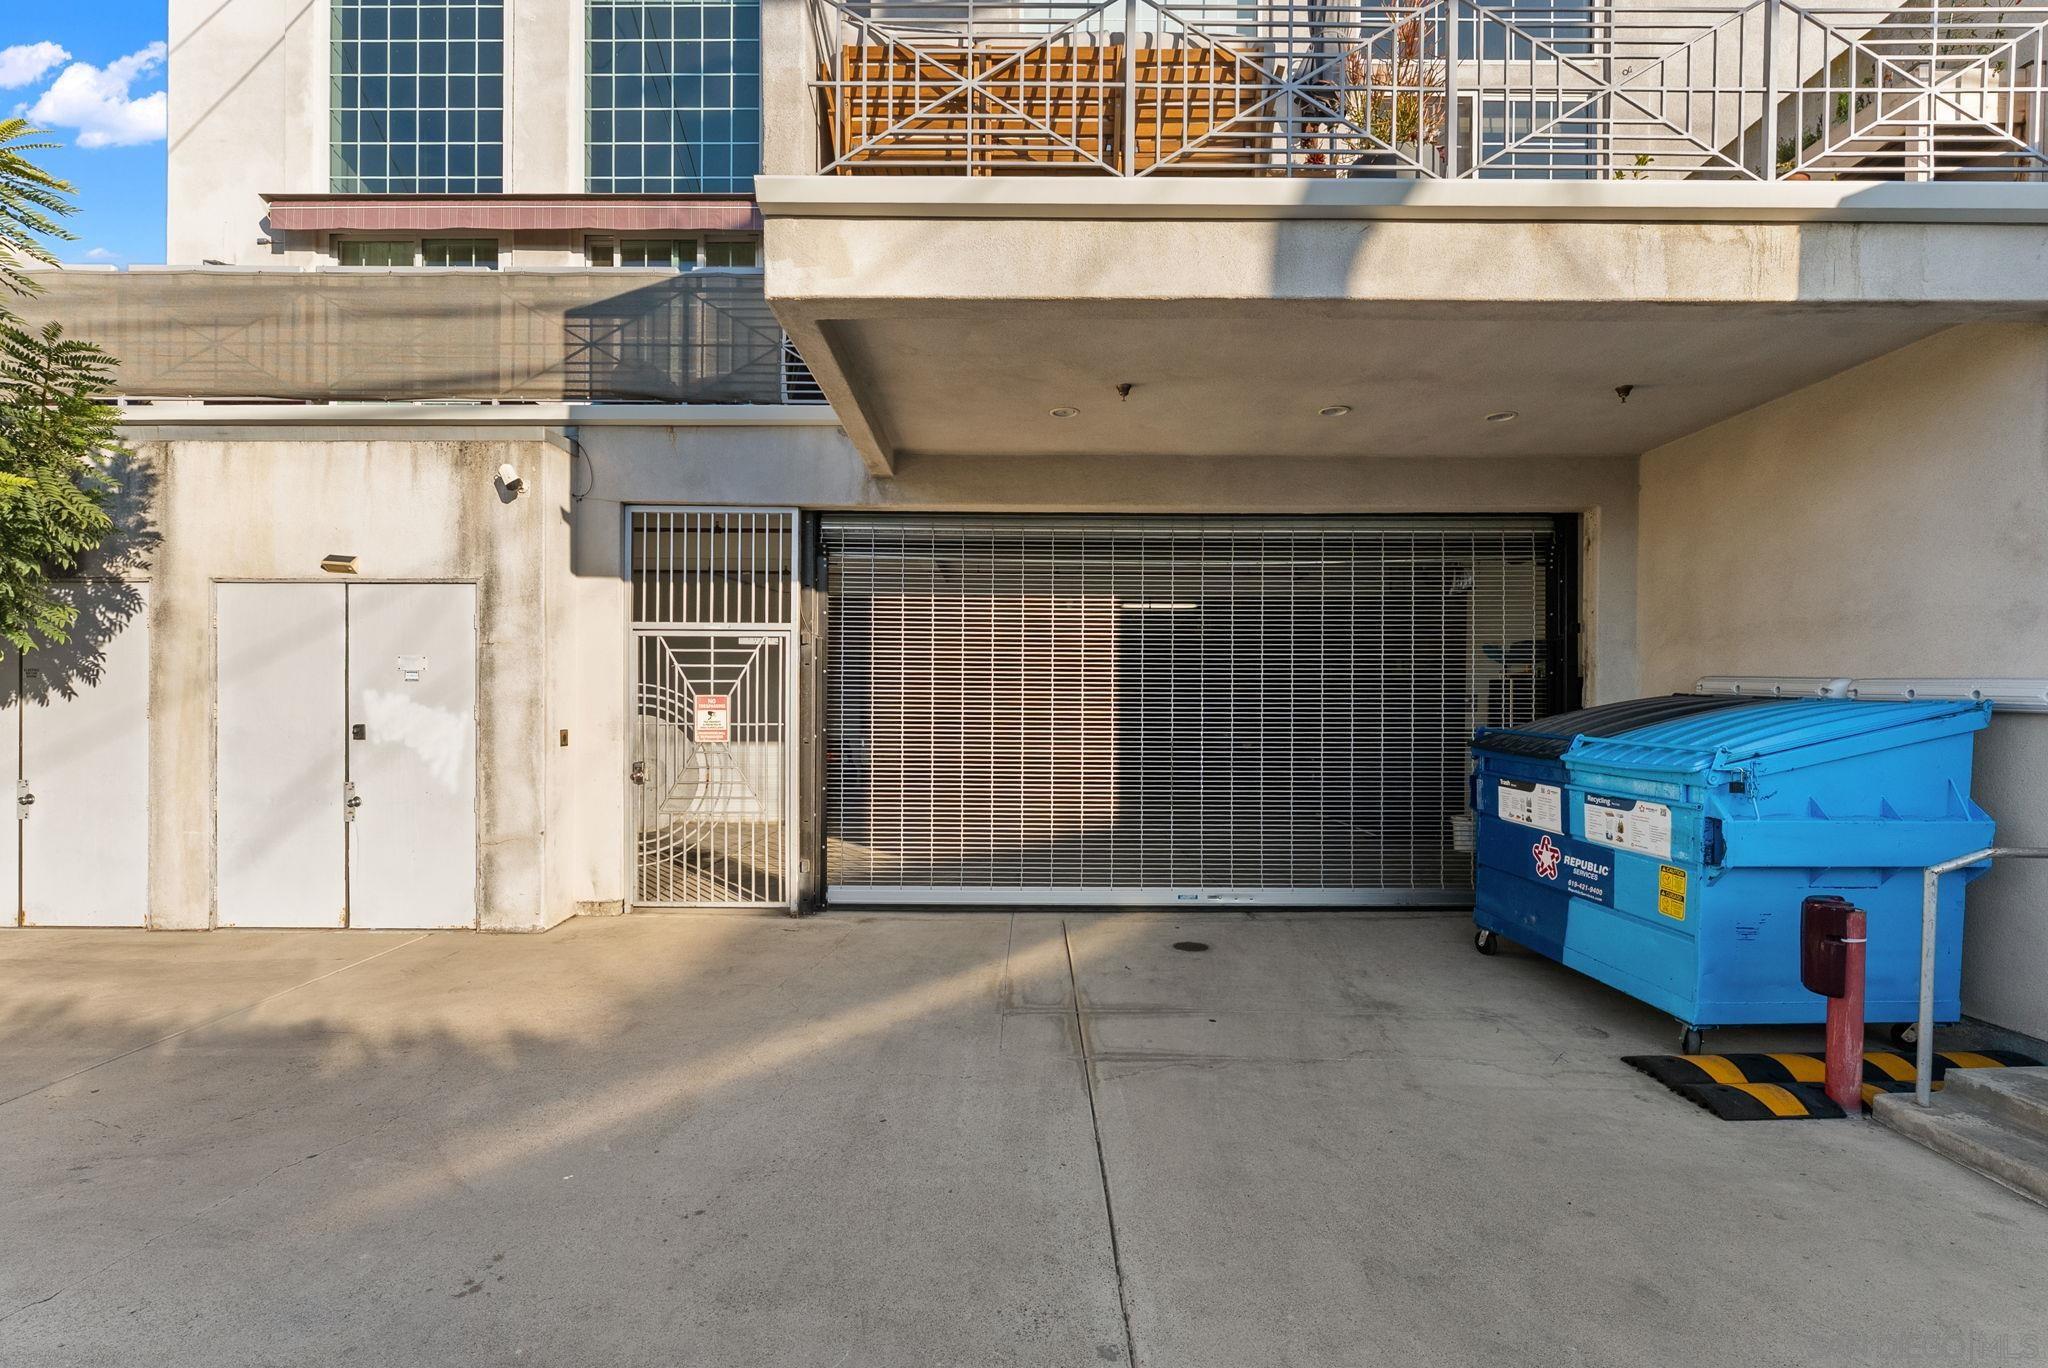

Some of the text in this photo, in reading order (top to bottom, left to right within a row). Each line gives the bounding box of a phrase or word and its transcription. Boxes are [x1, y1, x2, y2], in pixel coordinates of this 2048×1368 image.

[1587, 794, 1611, 806] Recycling
[1563, 855, 1609, 876] REPUBLIC
[1573, 867, 1599, 881] SERVICES
[1567, 879, 1603, 896] 619-421-9400
